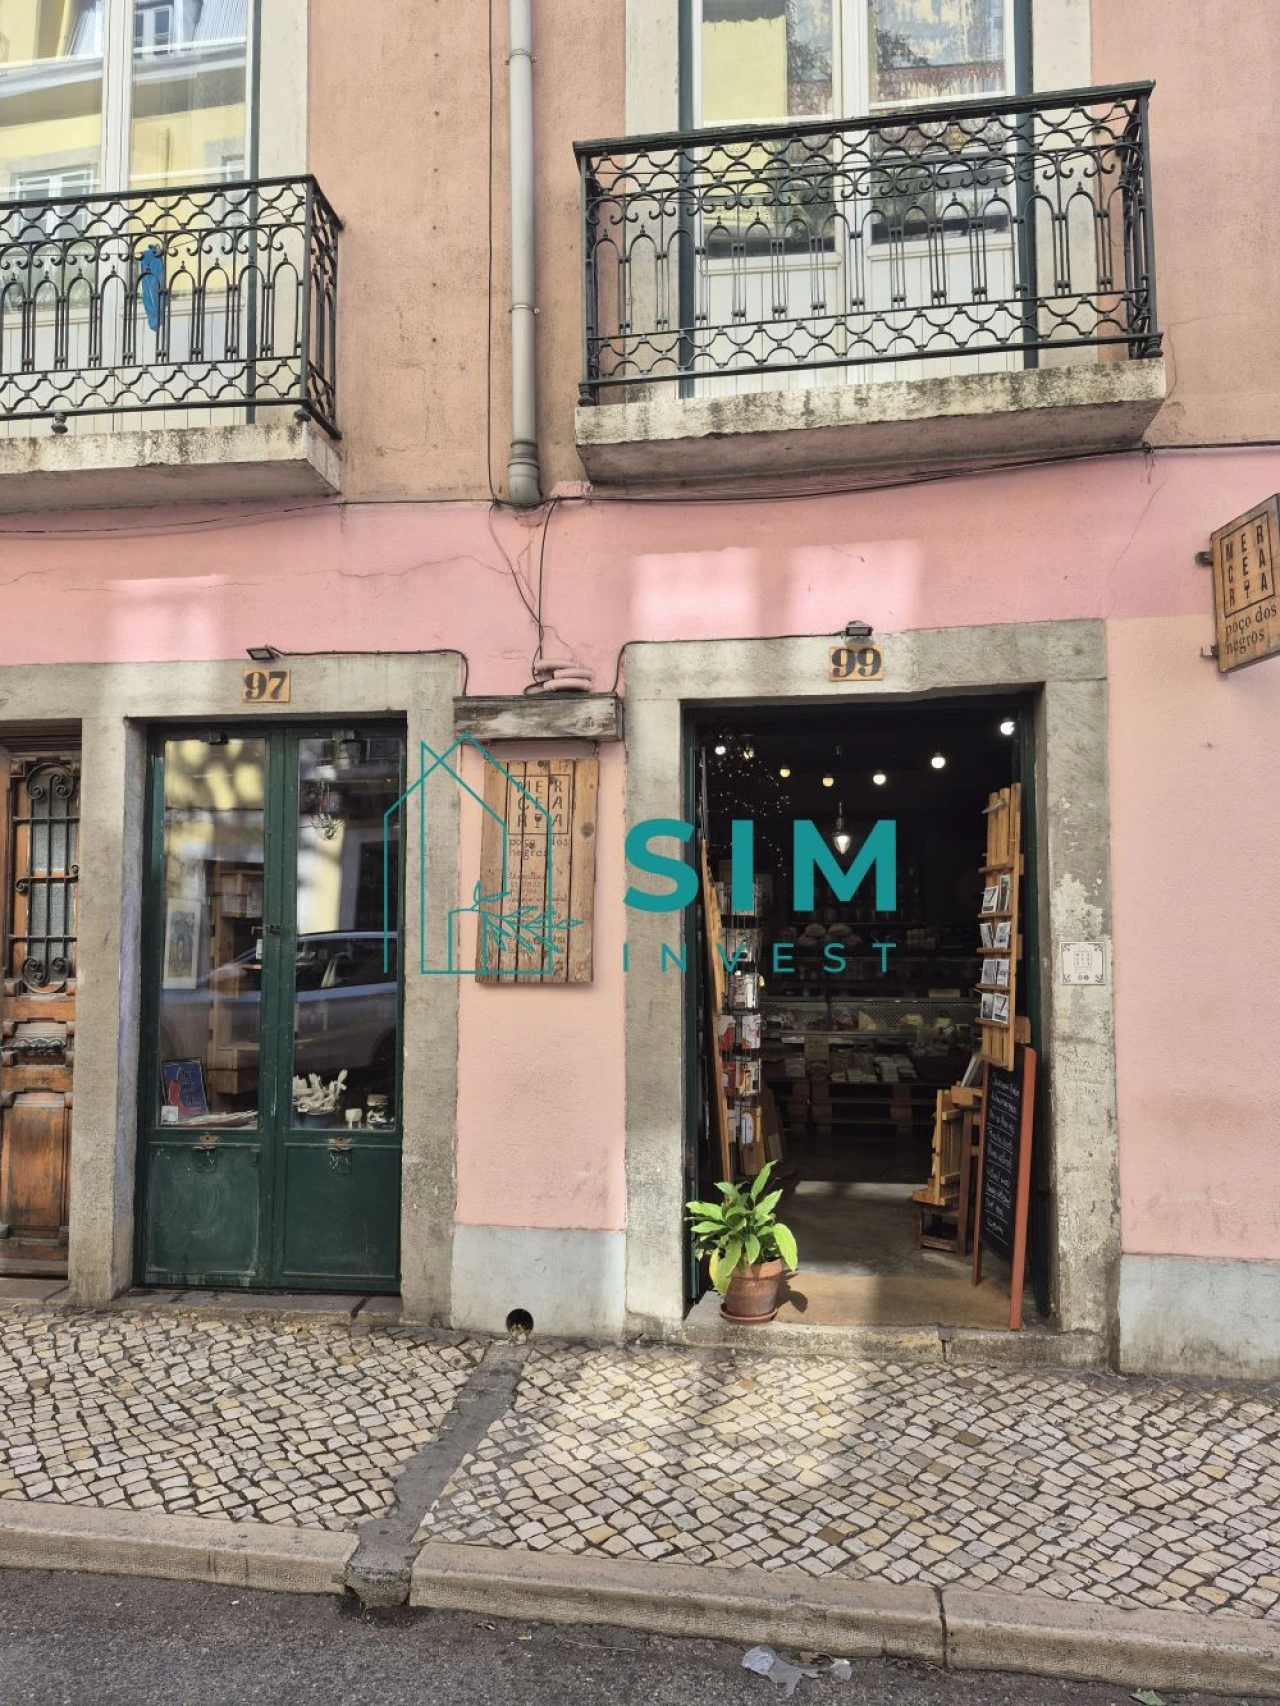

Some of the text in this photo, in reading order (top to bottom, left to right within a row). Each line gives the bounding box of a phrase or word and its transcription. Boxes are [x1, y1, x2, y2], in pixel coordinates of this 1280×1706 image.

[1225, 604, 1277, 644] poço dos
[1226, 628, 1266, 655] negros
[832, 648, 882, 677] 99
[244, 671, 288, 700] 97
